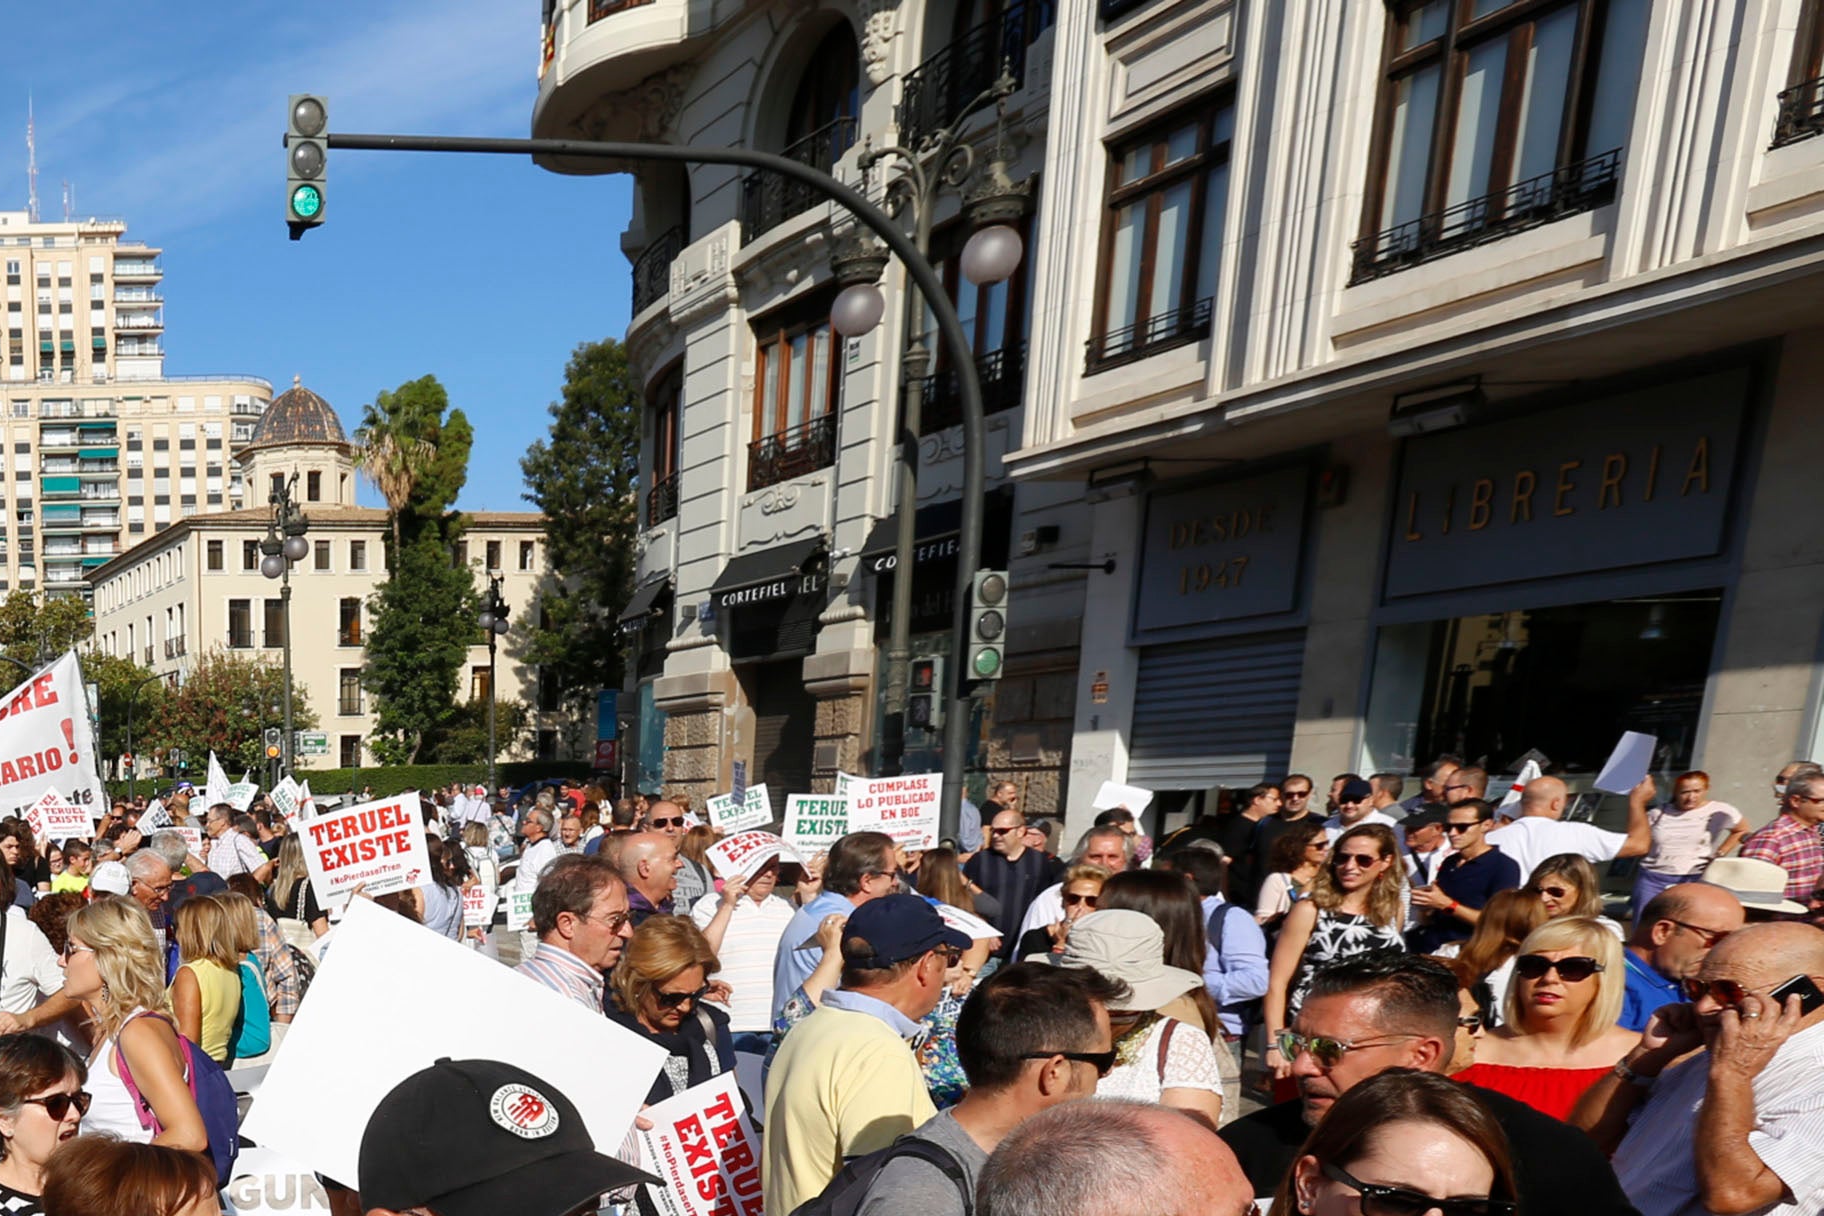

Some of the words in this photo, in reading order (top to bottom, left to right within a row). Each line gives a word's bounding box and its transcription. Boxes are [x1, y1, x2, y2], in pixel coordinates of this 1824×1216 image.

[1403, 436, 1712, 543] LIBRERIA
[1168, 503, 1276, 551] DESDE
[1177, 555, 1251, 596] 1947
[721, 582, 786, 607] CORTEFIEL
[869, 779, 929, 794] CUMPLASE
[796, 799, 848, 816] TERUE
[857, 797, 874, 809] LO
[878, 791, 936, 807] PUBLICADO
[47, 815, 87, 824] EXISTE
[309, 803, 411, 847] TERUEL
[881, 810, 897, 820] EN
[901, 807, 920, 819] BOE
[319, 830, 412, 872] EXISTE
